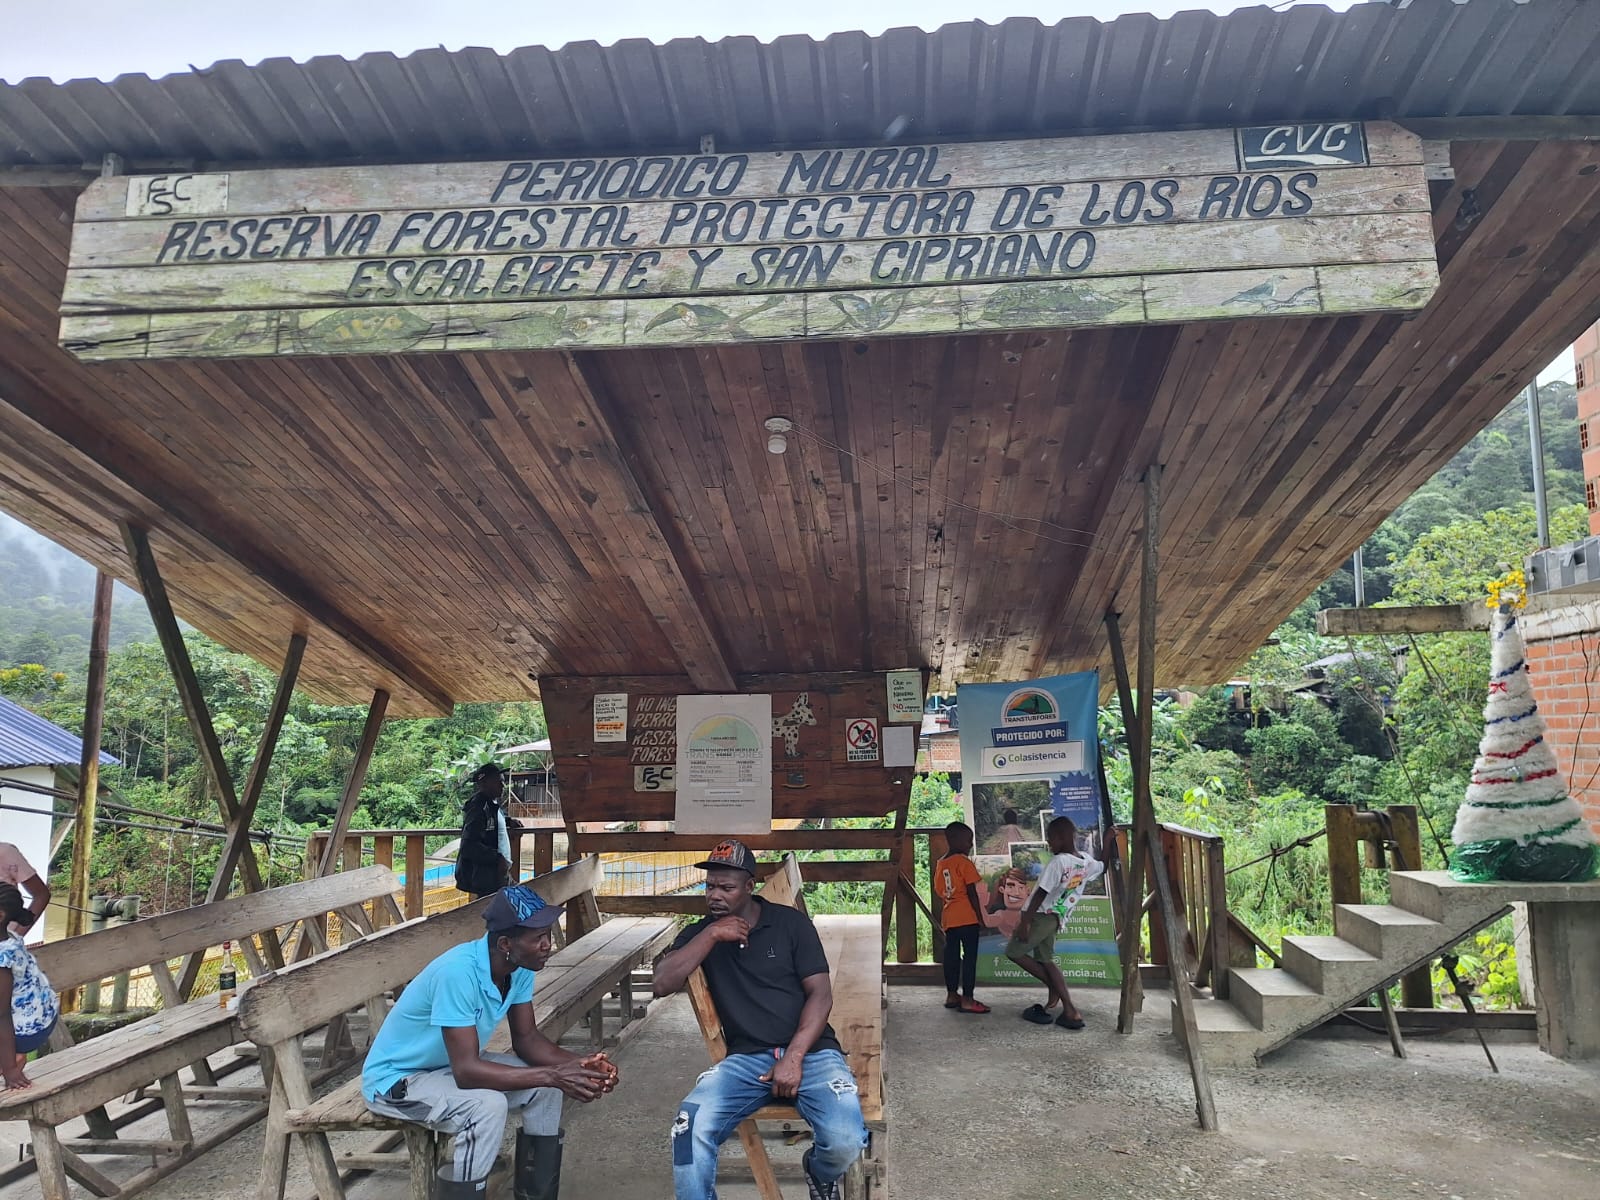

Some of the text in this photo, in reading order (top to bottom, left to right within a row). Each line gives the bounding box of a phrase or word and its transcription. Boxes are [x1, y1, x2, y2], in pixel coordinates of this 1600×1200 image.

[1259, 123, 1352, 156] CVC
[491, 145, 953, 203] PERIODICO MURAL
[156, 171, 1318, 264] RESERVA FORESTAL PROTECTORA DE LOS RIOS
[346, 229, 1096, 301] ESCALERETE Y SAN CIPRIANO
[636, 697, 655, 712] NO
[1004, 713, 1057, 723] TRANSTURFORES
[996, 728, 1066, 742] PROTEGIDO POR:
[1008, 750, 1067, 763] Colasistencia
